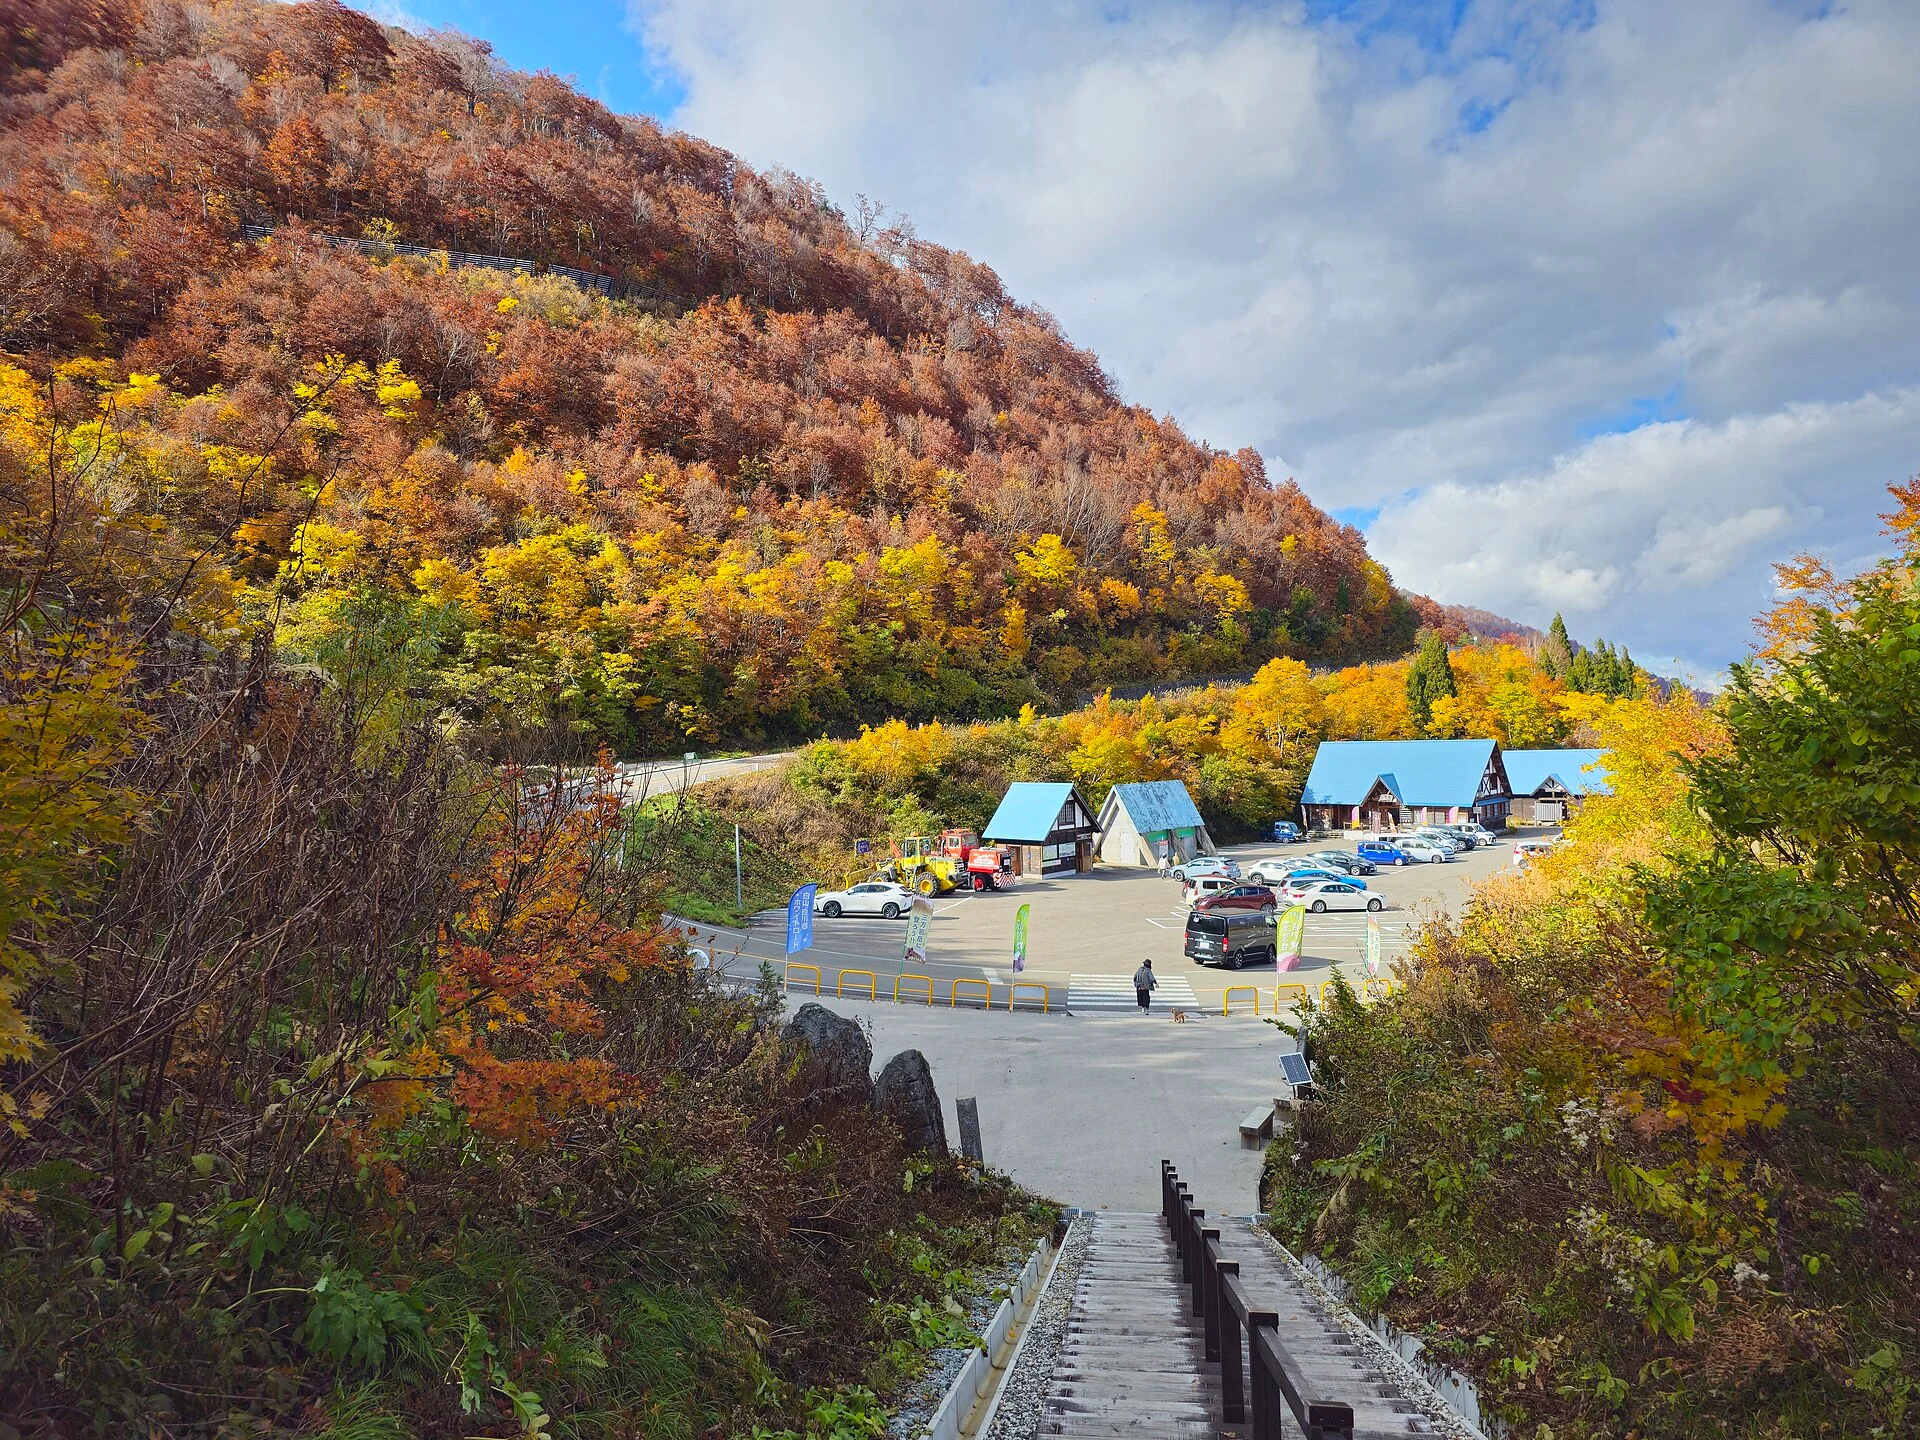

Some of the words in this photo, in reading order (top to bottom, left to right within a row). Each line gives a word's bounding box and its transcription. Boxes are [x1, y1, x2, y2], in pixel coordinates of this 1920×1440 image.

[793, 899, 802, 948] ホワイトロード
